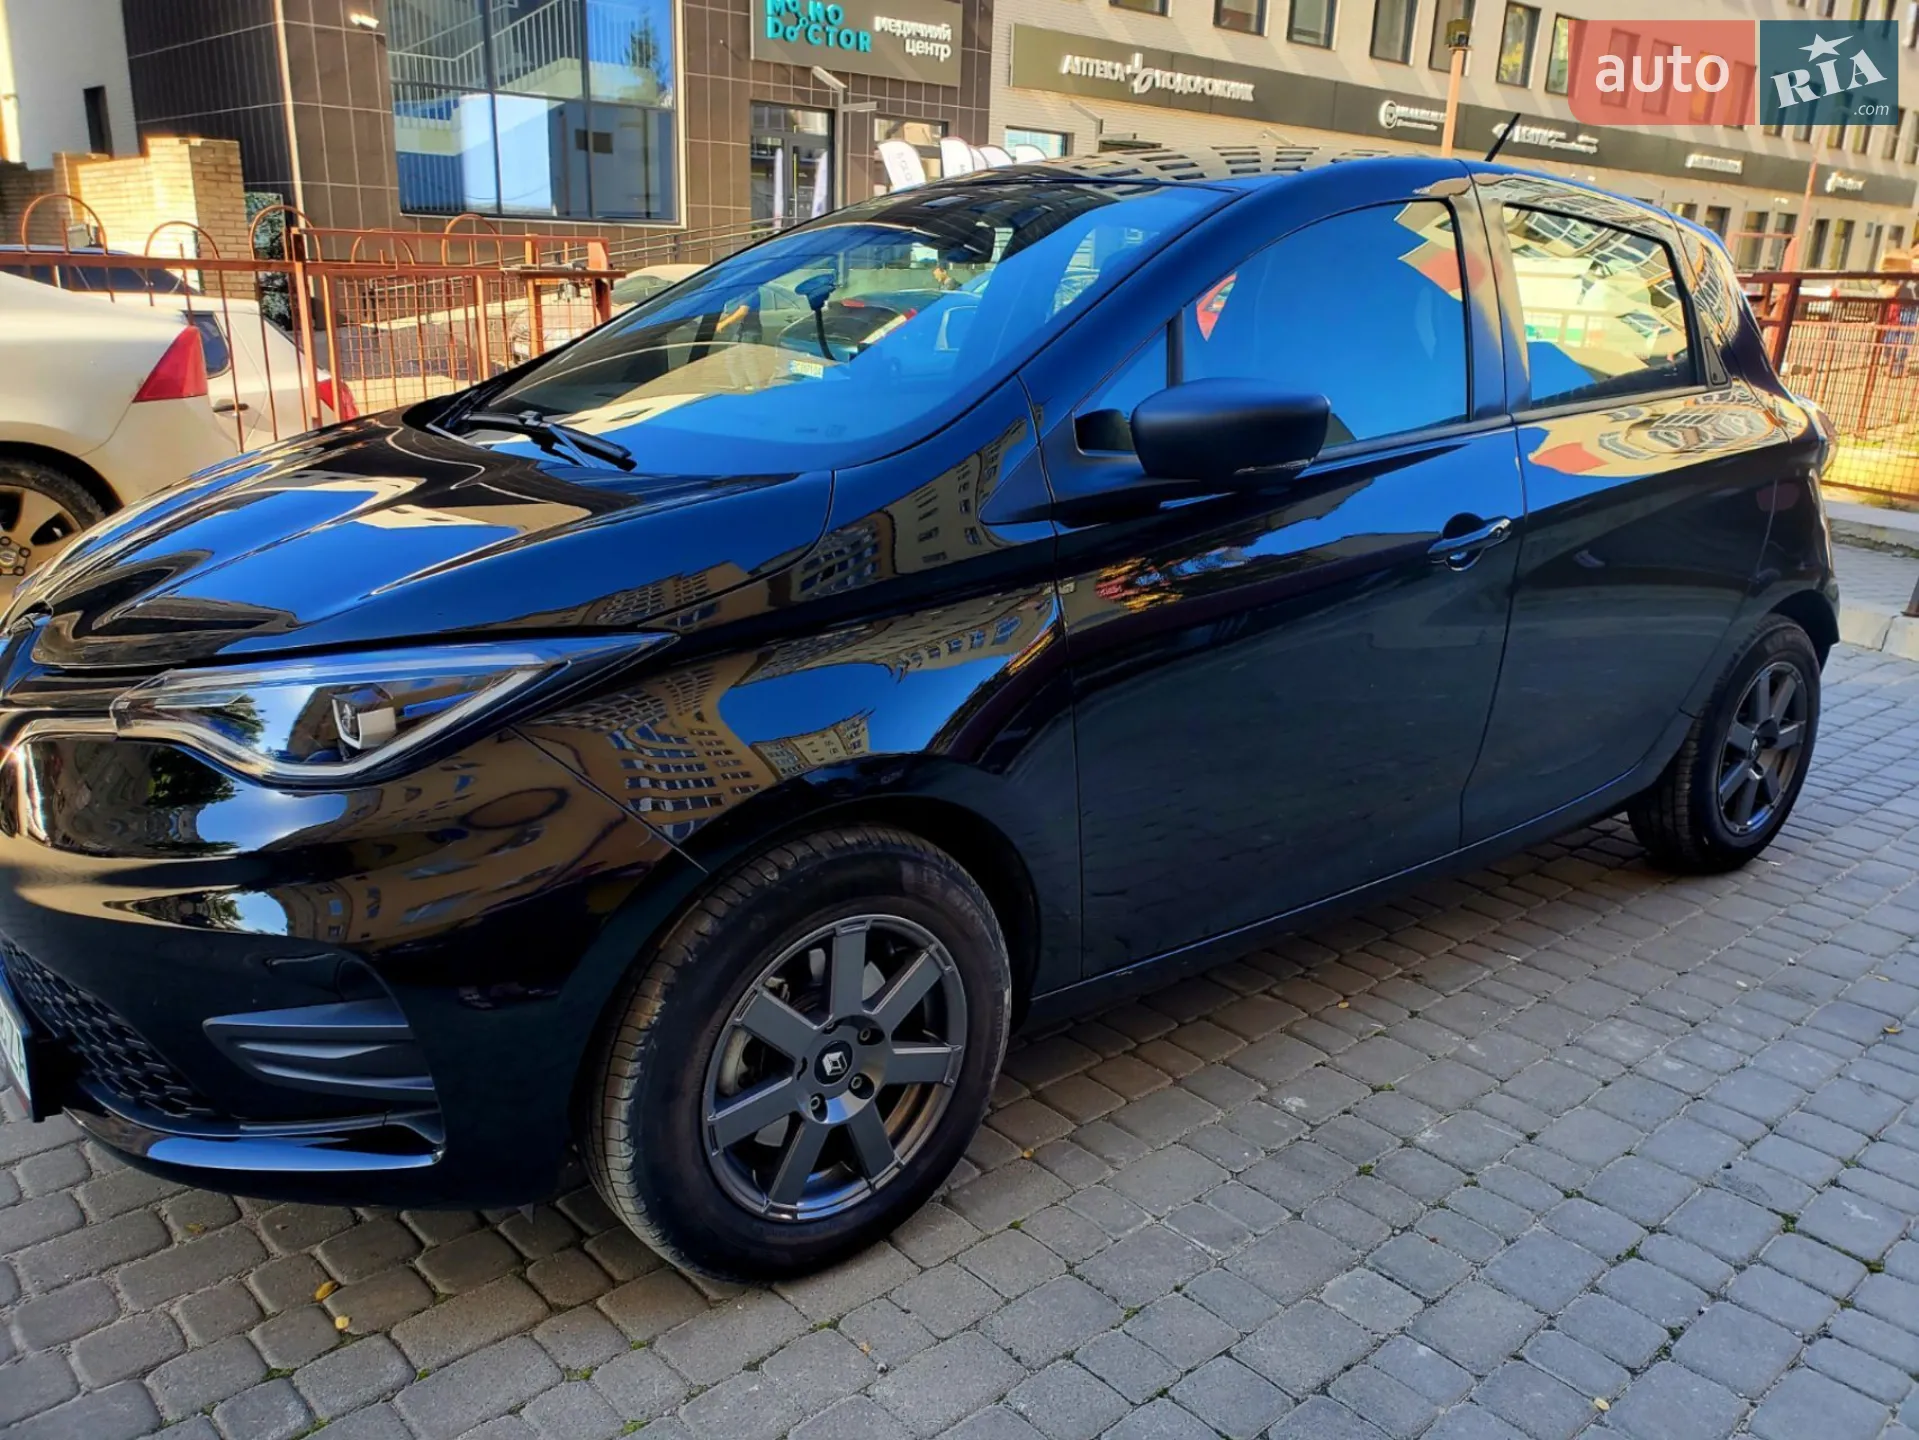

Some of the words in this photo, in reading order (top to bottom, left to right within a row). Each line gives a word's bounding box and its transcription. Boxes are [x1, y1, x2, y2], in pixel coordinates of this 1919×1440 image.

[905, 39, 952, 62] центр
[1060, 55, 1125, 82] АПТЕКА
[1155, 69, 1254, 101] ПОДОРОЖНИК
